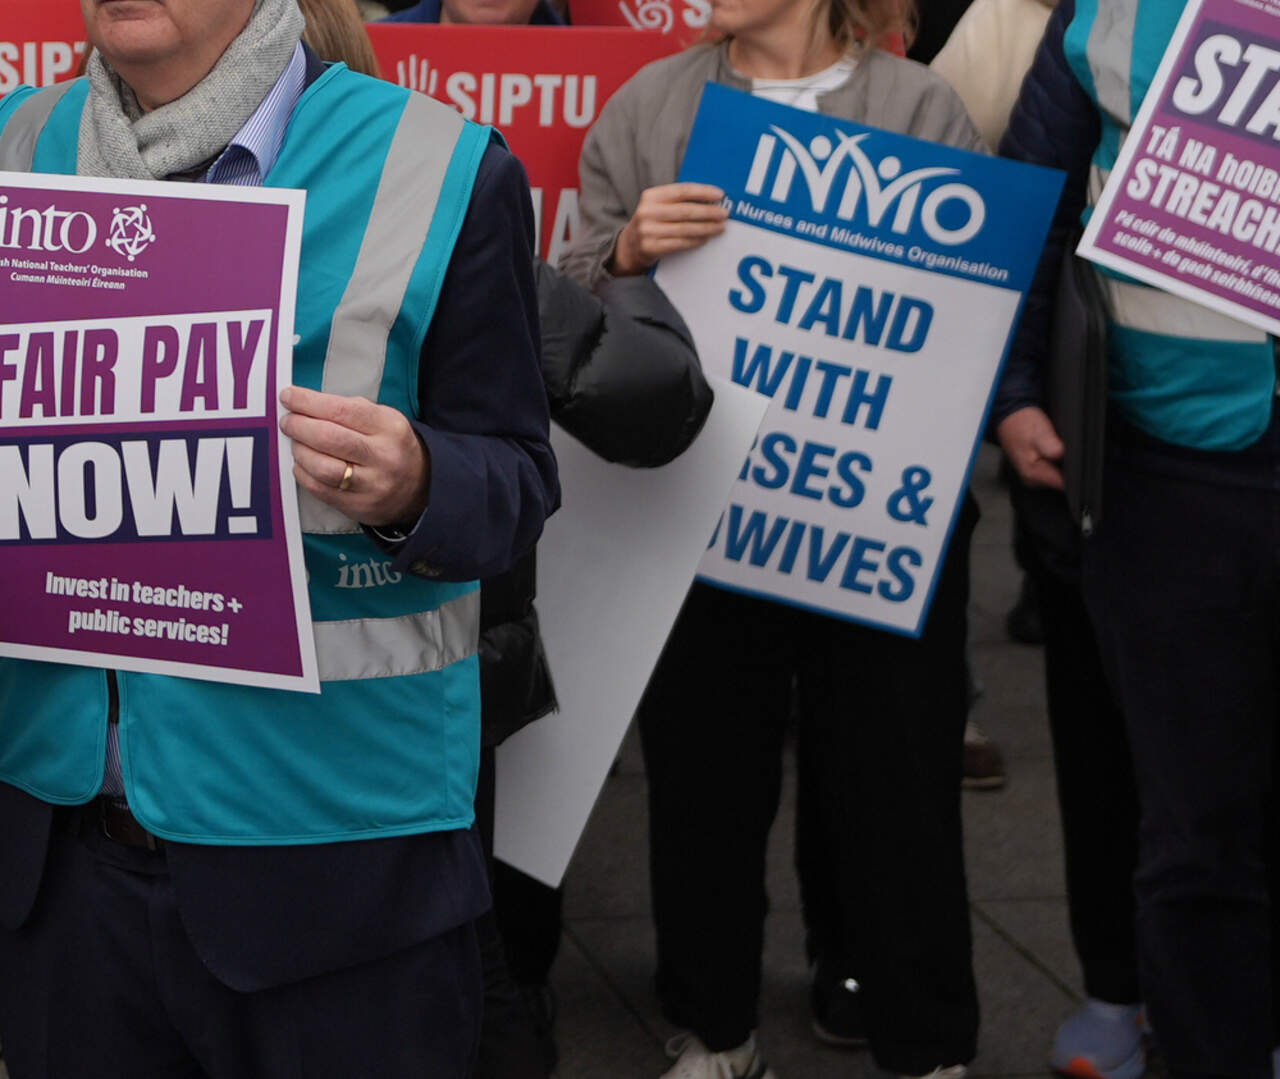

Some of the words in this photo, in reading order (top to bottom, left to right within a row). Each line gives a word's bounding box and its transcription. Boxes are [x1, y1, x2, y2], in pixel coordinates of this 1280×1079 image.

[446, 72, 597, 128] SIPTU
[745, 124, 986, 246] INMO
[1146, 124, 1181, 161] TÁ
[1178, 138, 1217, 176] NA
[736, 200, 792, 229] Nurses
[796, 217, 827, 239] and
[830, 225, 905, 258] Midwives
[907, 244, 1009, 283] Organisation
[1126, 158, 1280, 256] STREACH
[10, 272, 45, 284] Cumann
[11, 259, 48, 271] National
[91, 265, 149, 279] Organisation
[728, 255, 935, 355] STAND
[140, 319, 266, 413] PAY
[730, 337, 892, 431] WITH
[738, 431, 872, 510] SES
[886, 465, 936, 528] &
[45, 571, 109, 604] Invest
[110, 576, 130, 604] in
[132, 580, 225, 614] teachers
[227, 595, 244, 614] +
[708, 504, 923, 604] WIVES
[68, 607, 130, 638] public
[132, 619, 229, 646] services!
